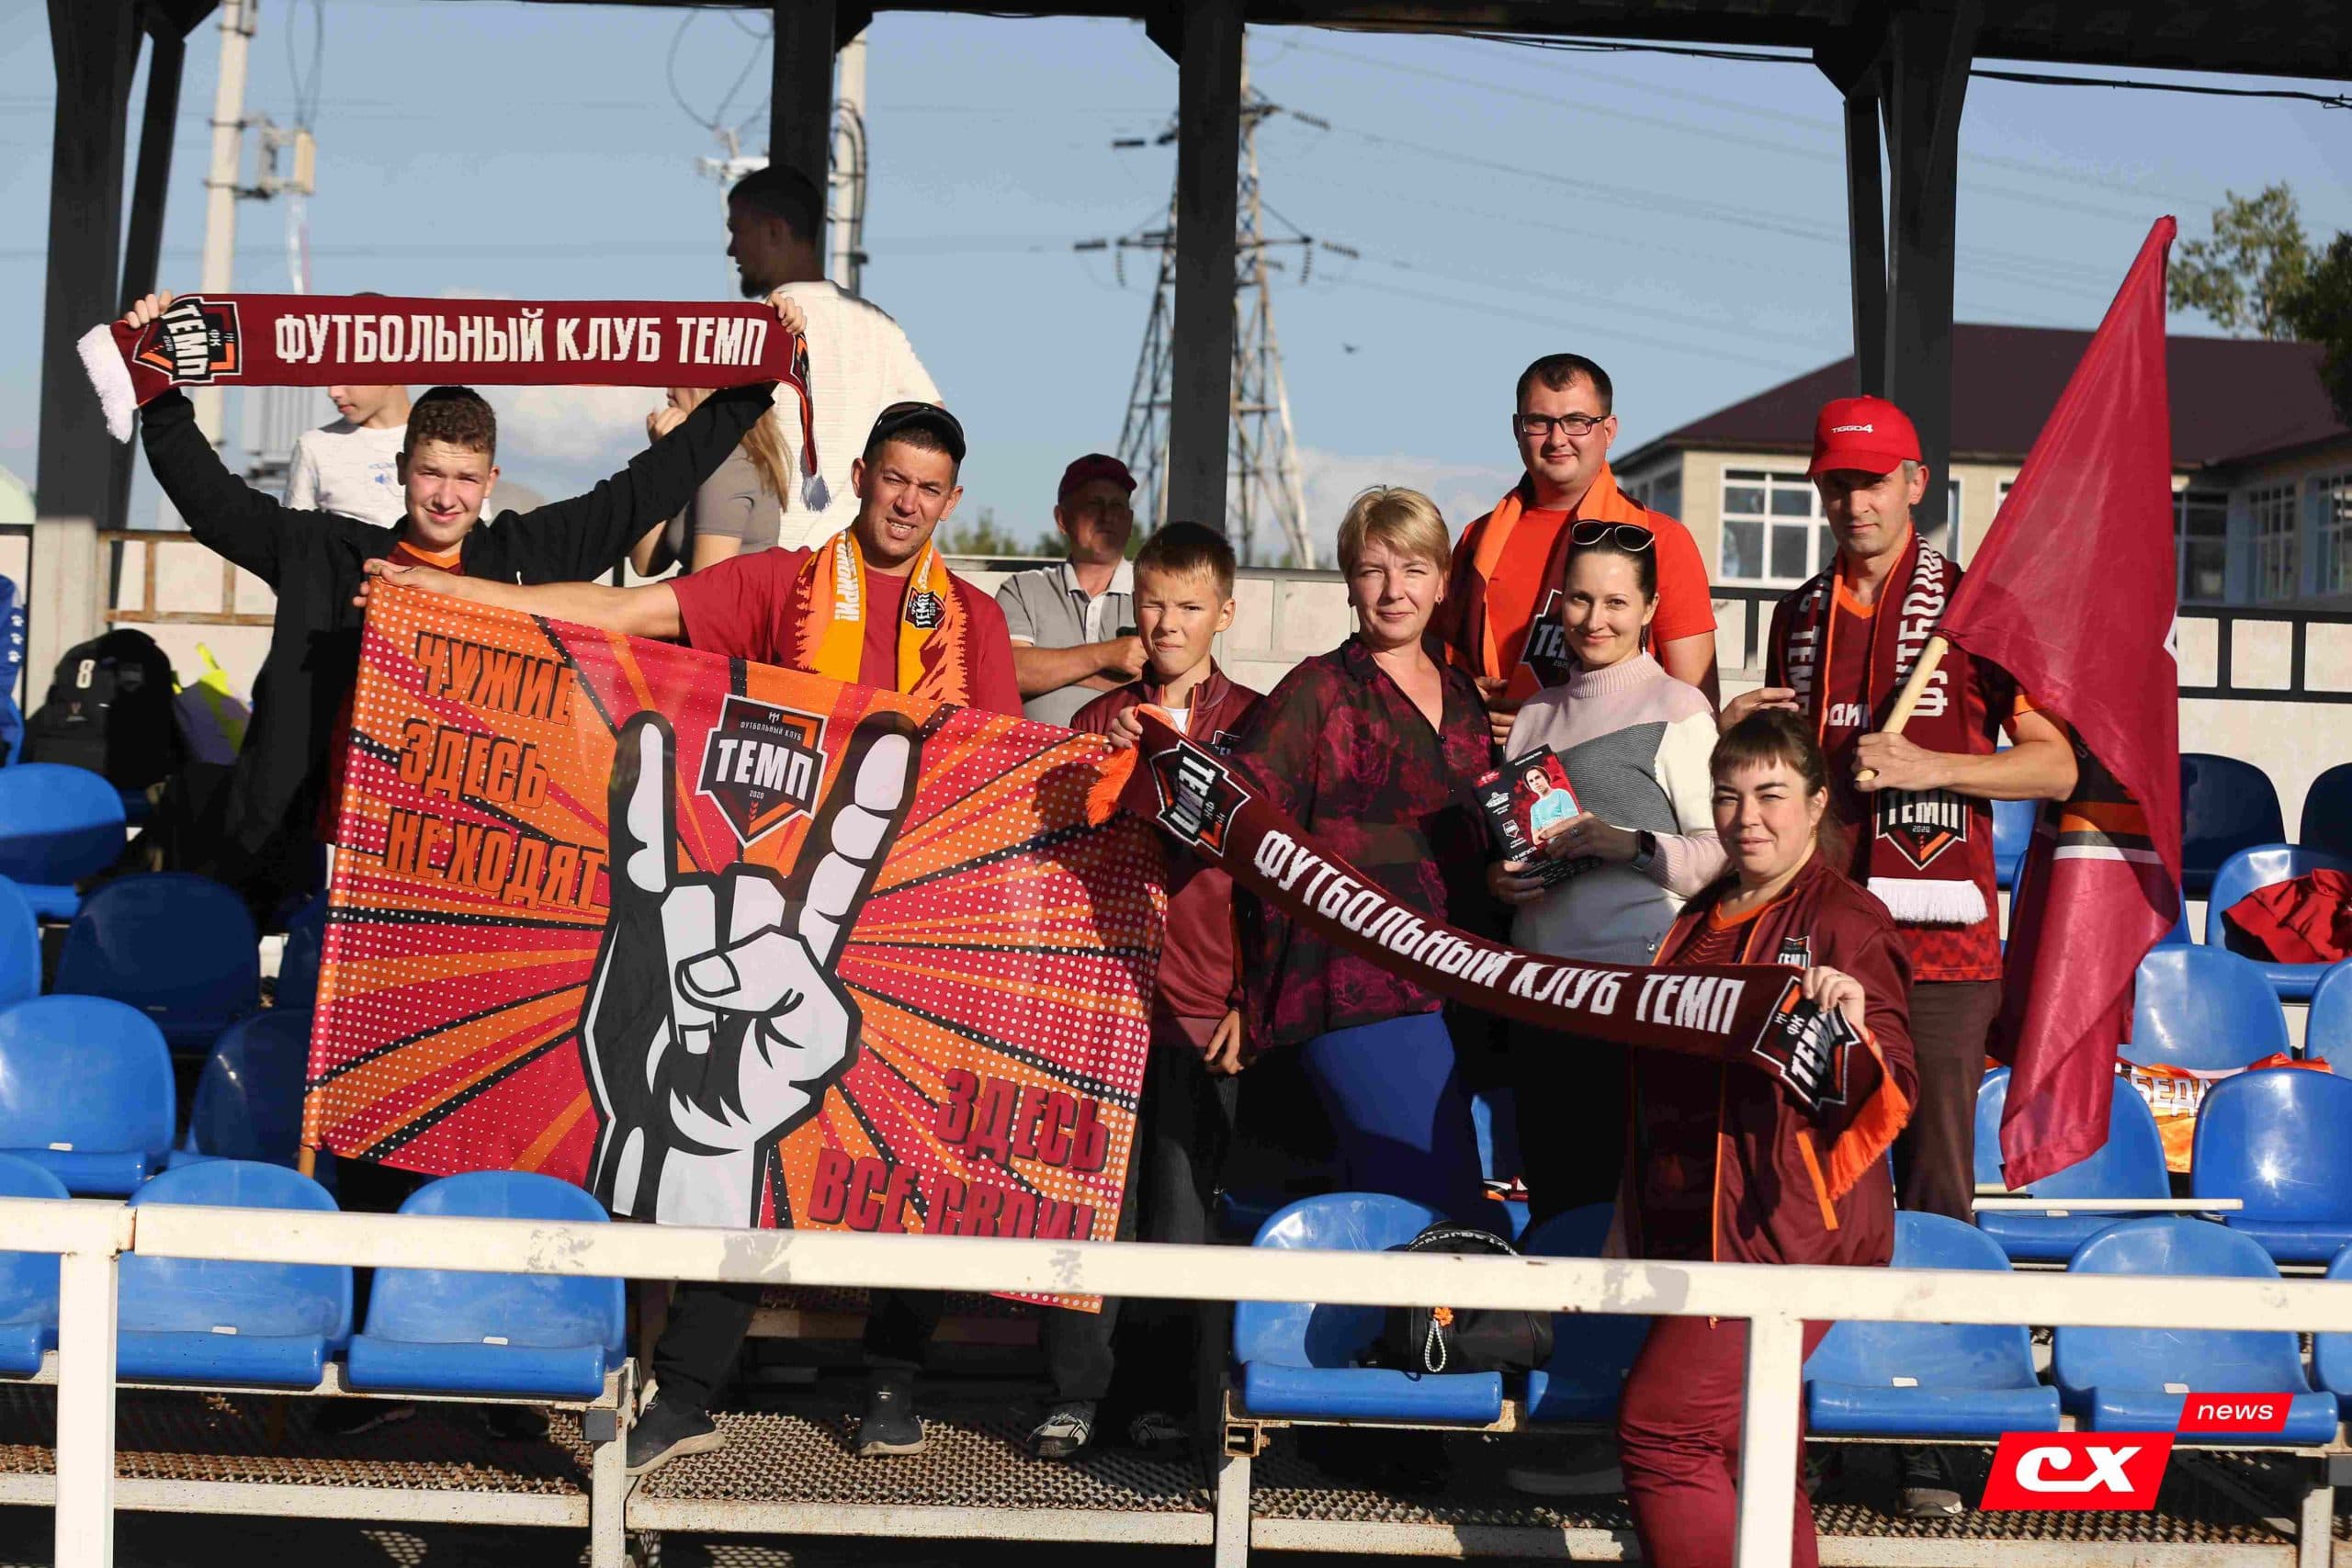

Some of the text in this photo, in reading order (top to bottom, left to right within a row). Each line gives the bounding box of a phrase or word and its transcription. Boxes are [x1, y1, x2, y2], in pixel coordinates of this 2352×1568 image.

[160, 304, 209, 375] ТЕМП
[274, 307, 768, 366] ФУТБОЛЬНЫЙ КЛУБ ТЕМП
[916, 592, 932, 626] ТЕМП
[1533, 625, 1567, 660] ТЕ
[76, 660, 96, 689] 8
[416, 630, 579, 726] ЧУЖИЕ
[740, 721, 801, 741] ФУТБОЛЬНЫЙ КЛУБ
[400, 717, 548, 809] ЗДЕСЬ
[716, 739, 813, 801] ТЕМП
[749, 790, 764, 799] 2020
[1170, 756, 1216, 834] ТЕМП
[1887, 791, 1959, 829] ТЕМП
[385, 807, 608, 911] НЕ ХОДЯТ
[1253, 829, 1527, 988] ФУТБОЛЬНЫЙ
[1509, 962, 1633, 1015] КЛУБ
[1635, 974, 1745, 1035] ТЕМП
[1787, 1013, 1805, 1035] ФК
[935, 1067, 1111, 1173] ЗДЕСЬ
[807, 1147, 920, 1234] ВСЕ
